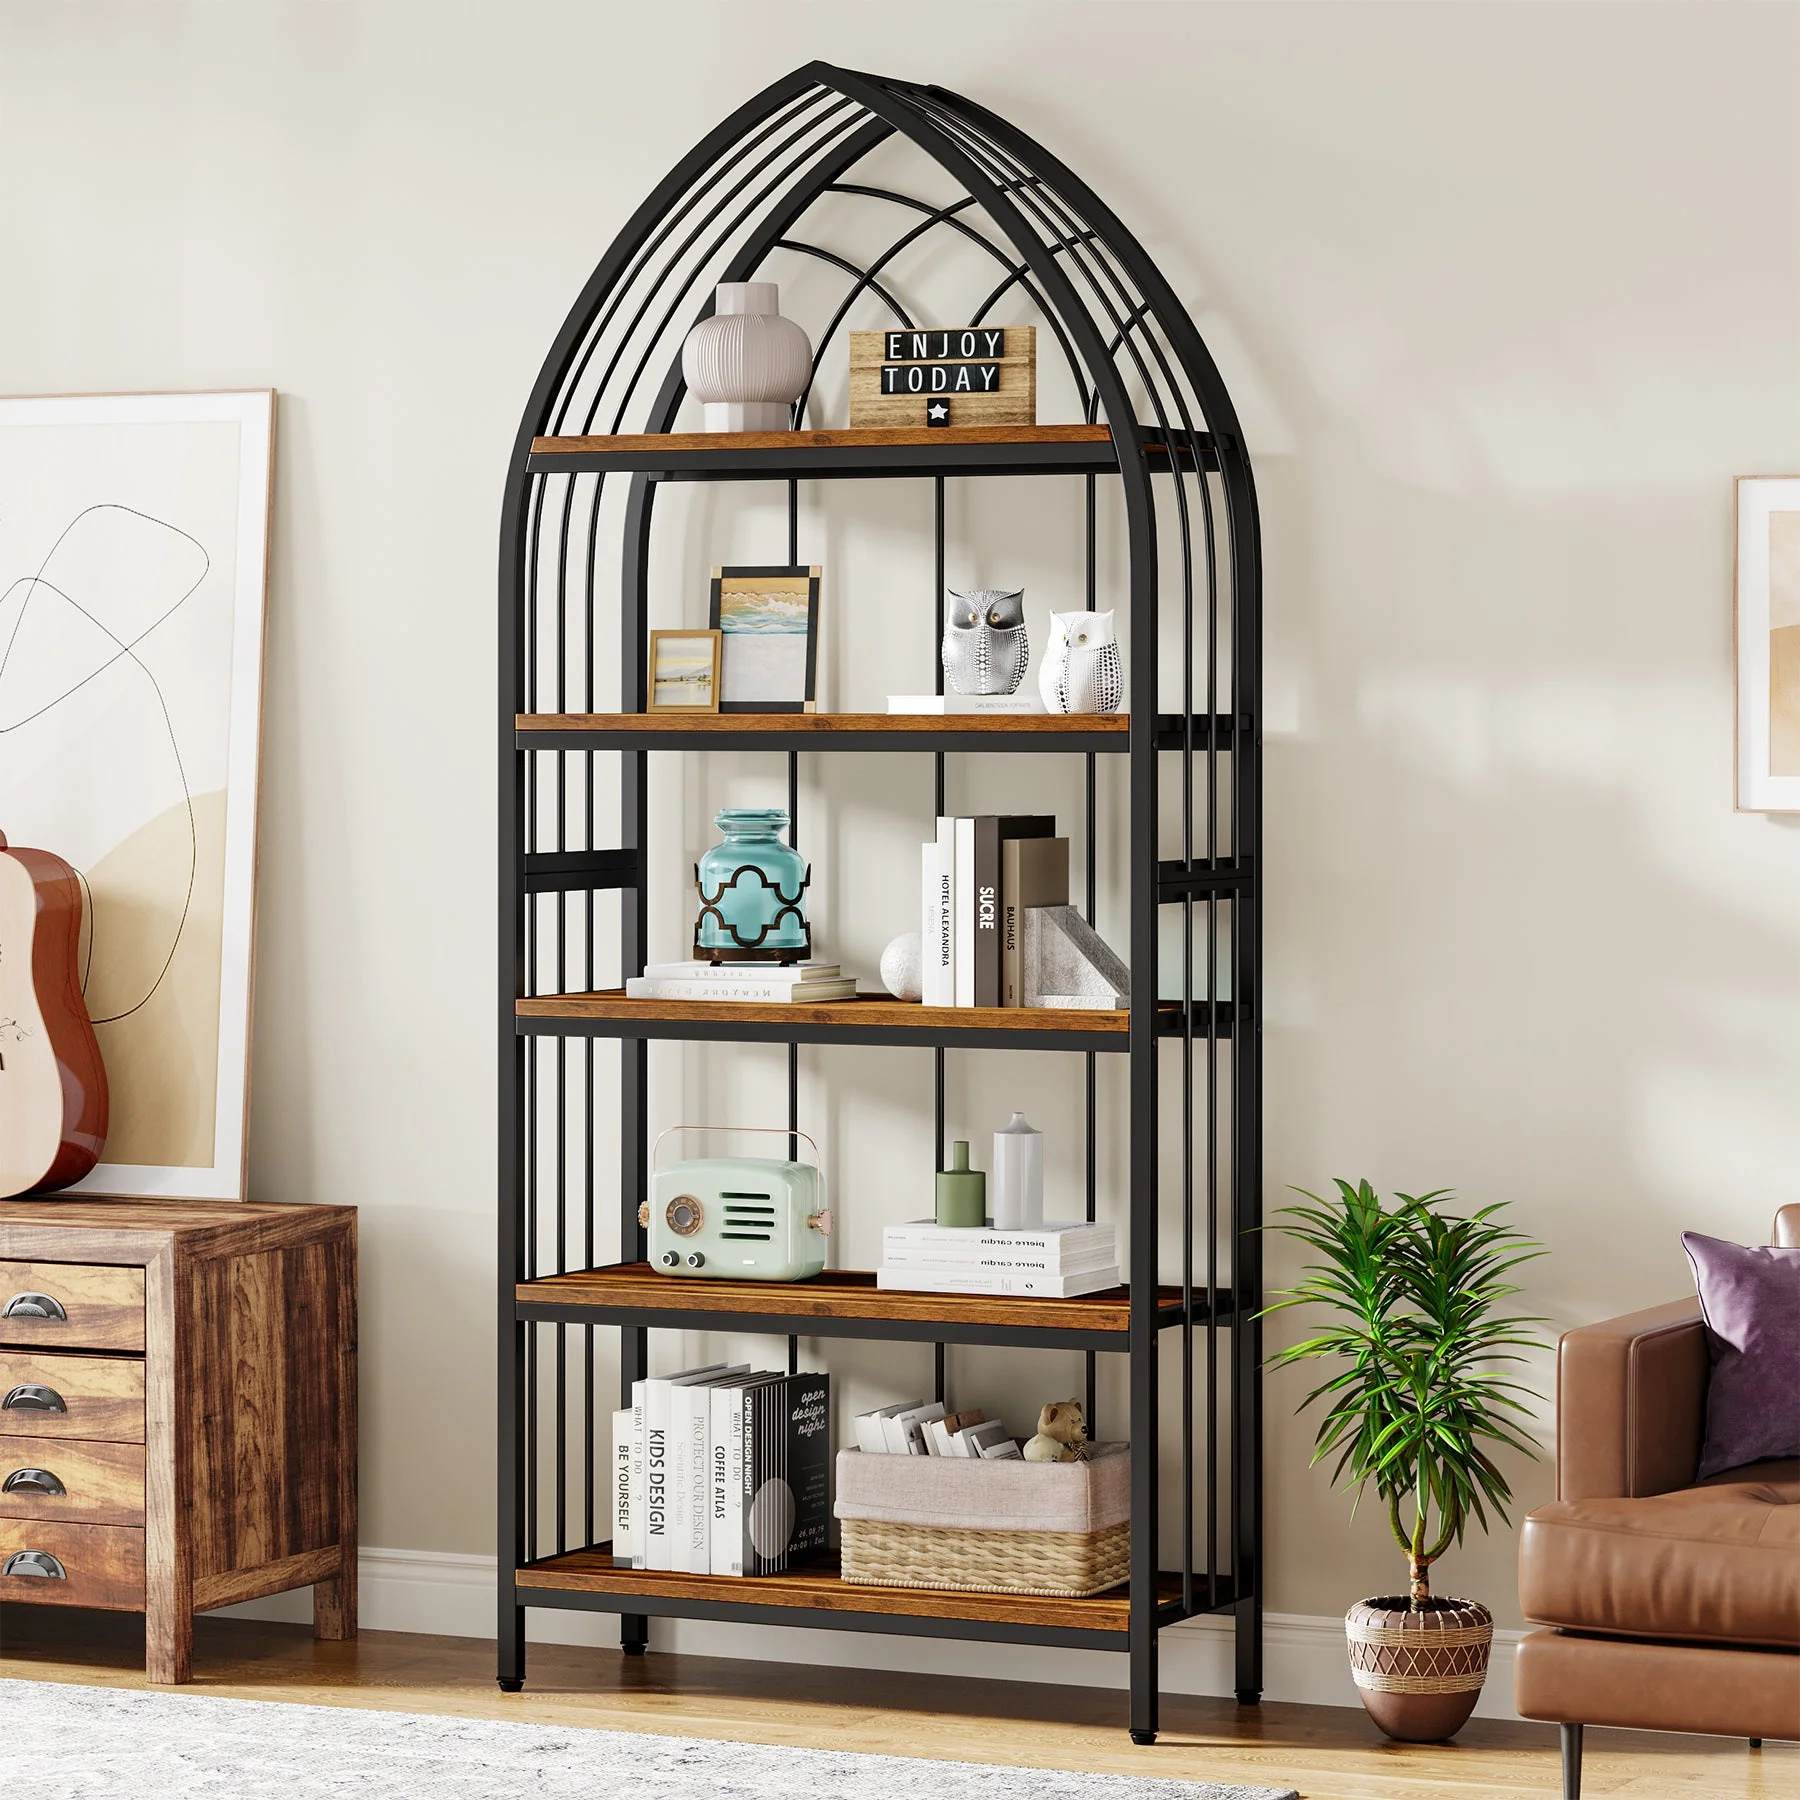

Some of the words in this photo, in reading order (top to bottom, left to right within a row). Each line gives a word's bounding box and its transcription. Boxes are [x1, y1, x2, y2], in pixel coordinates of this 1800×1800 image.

[889, 331, 1000, 359] ENJOY
[884, 366, 996, 392] TODAY
[941, 874, 950, 904] HOTEL
[979, 886, 995, 930] SUCRE
[941, 909, 950, 967] ALEXANDRA
[1006, 906, 1015, 951] BAUHAUS
[744, 1396, 752, 1424] OPEN
[792, 1404, 825, 1421] design
[801, 1390, 826, 1406] open
[634, 1406, 643, 1432] WHAT
[733, 1412, 742, 1439] WHAT
[798, 1418, 825, 1437] night
[618, 1445, 629, 1461] BE
[634, 1442, 643, 1454] TO
[649, 1429, 665, 1468] KIDS
[693, 1416, 705, 1473] PROTECT
[733, 1447, 742, 1461] TO
[744, 1426, 752, 1463] DESIGN
[634, 1460, 642, 1475] DO
[676, 1441, 686, 1487] Scientific
[715, 1445, 725, 1483] COFFEE
[733, 1465, 742, 1481] DO
[693, 1474, 705, 1502] OUR
[744, 1465, 752, 1497] NIGHT
[618, 1465, 629, 1531] YOURSELF
[649, 1473, 665, 1536] DESIGN
[676, 1491, 686, 1526] Design
[715, 1487, 725, 1519] ATLAS
[692, 1505, 704, 1550] DESIGN
